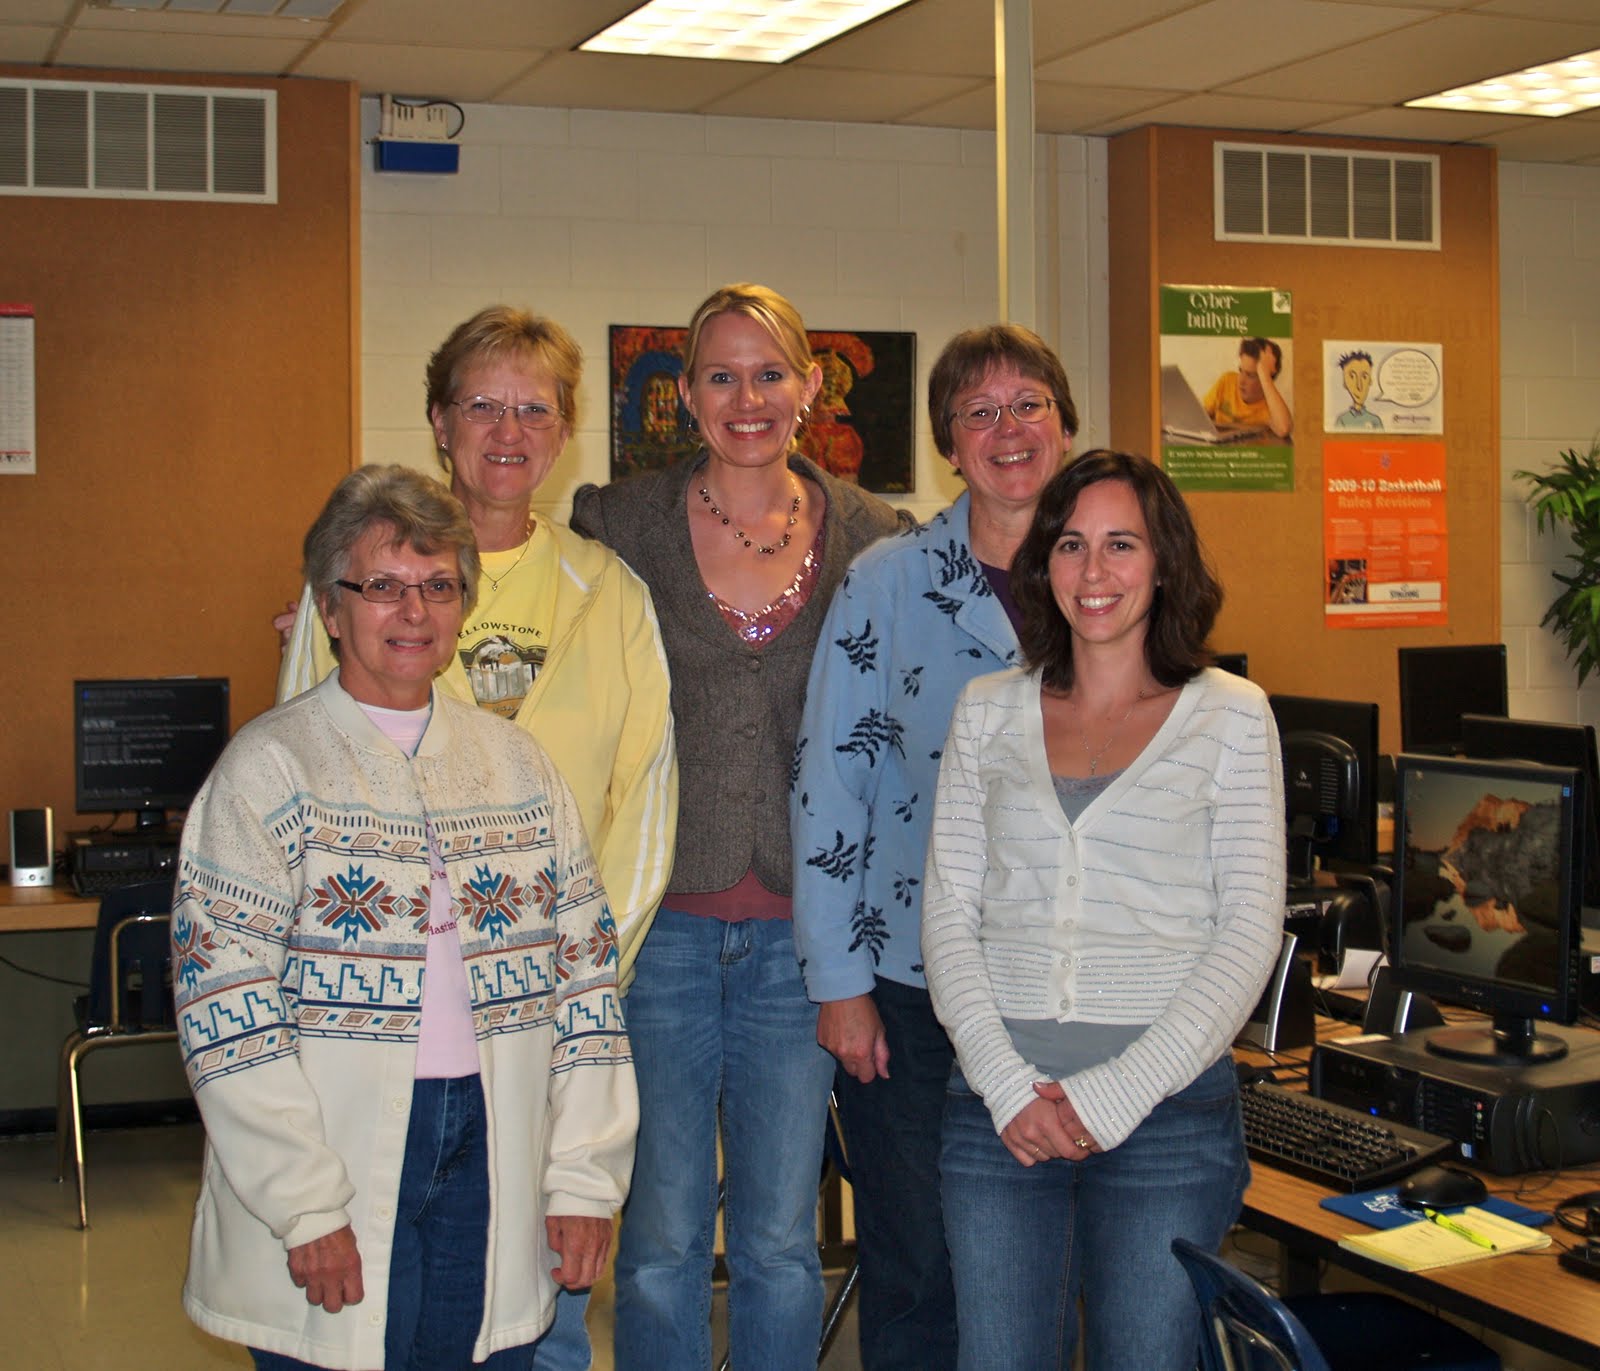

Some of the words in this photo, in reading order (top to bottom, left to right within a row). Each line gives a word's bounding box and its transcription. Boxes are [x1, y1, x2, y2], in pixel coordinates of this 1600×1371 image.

[1190, 292, 1240, 313] Cyber-
[1187, 311, 1249, 334] bullying
[1328, 479, 1376, 493] 2009-10
[1379, 478, 1442, 493] Basketball
[1338, 496, 1372, 508] Rules
[1376, 496, 1432, 509] Revisions
[457, 621, 543, 640] ELLOWSTONE
